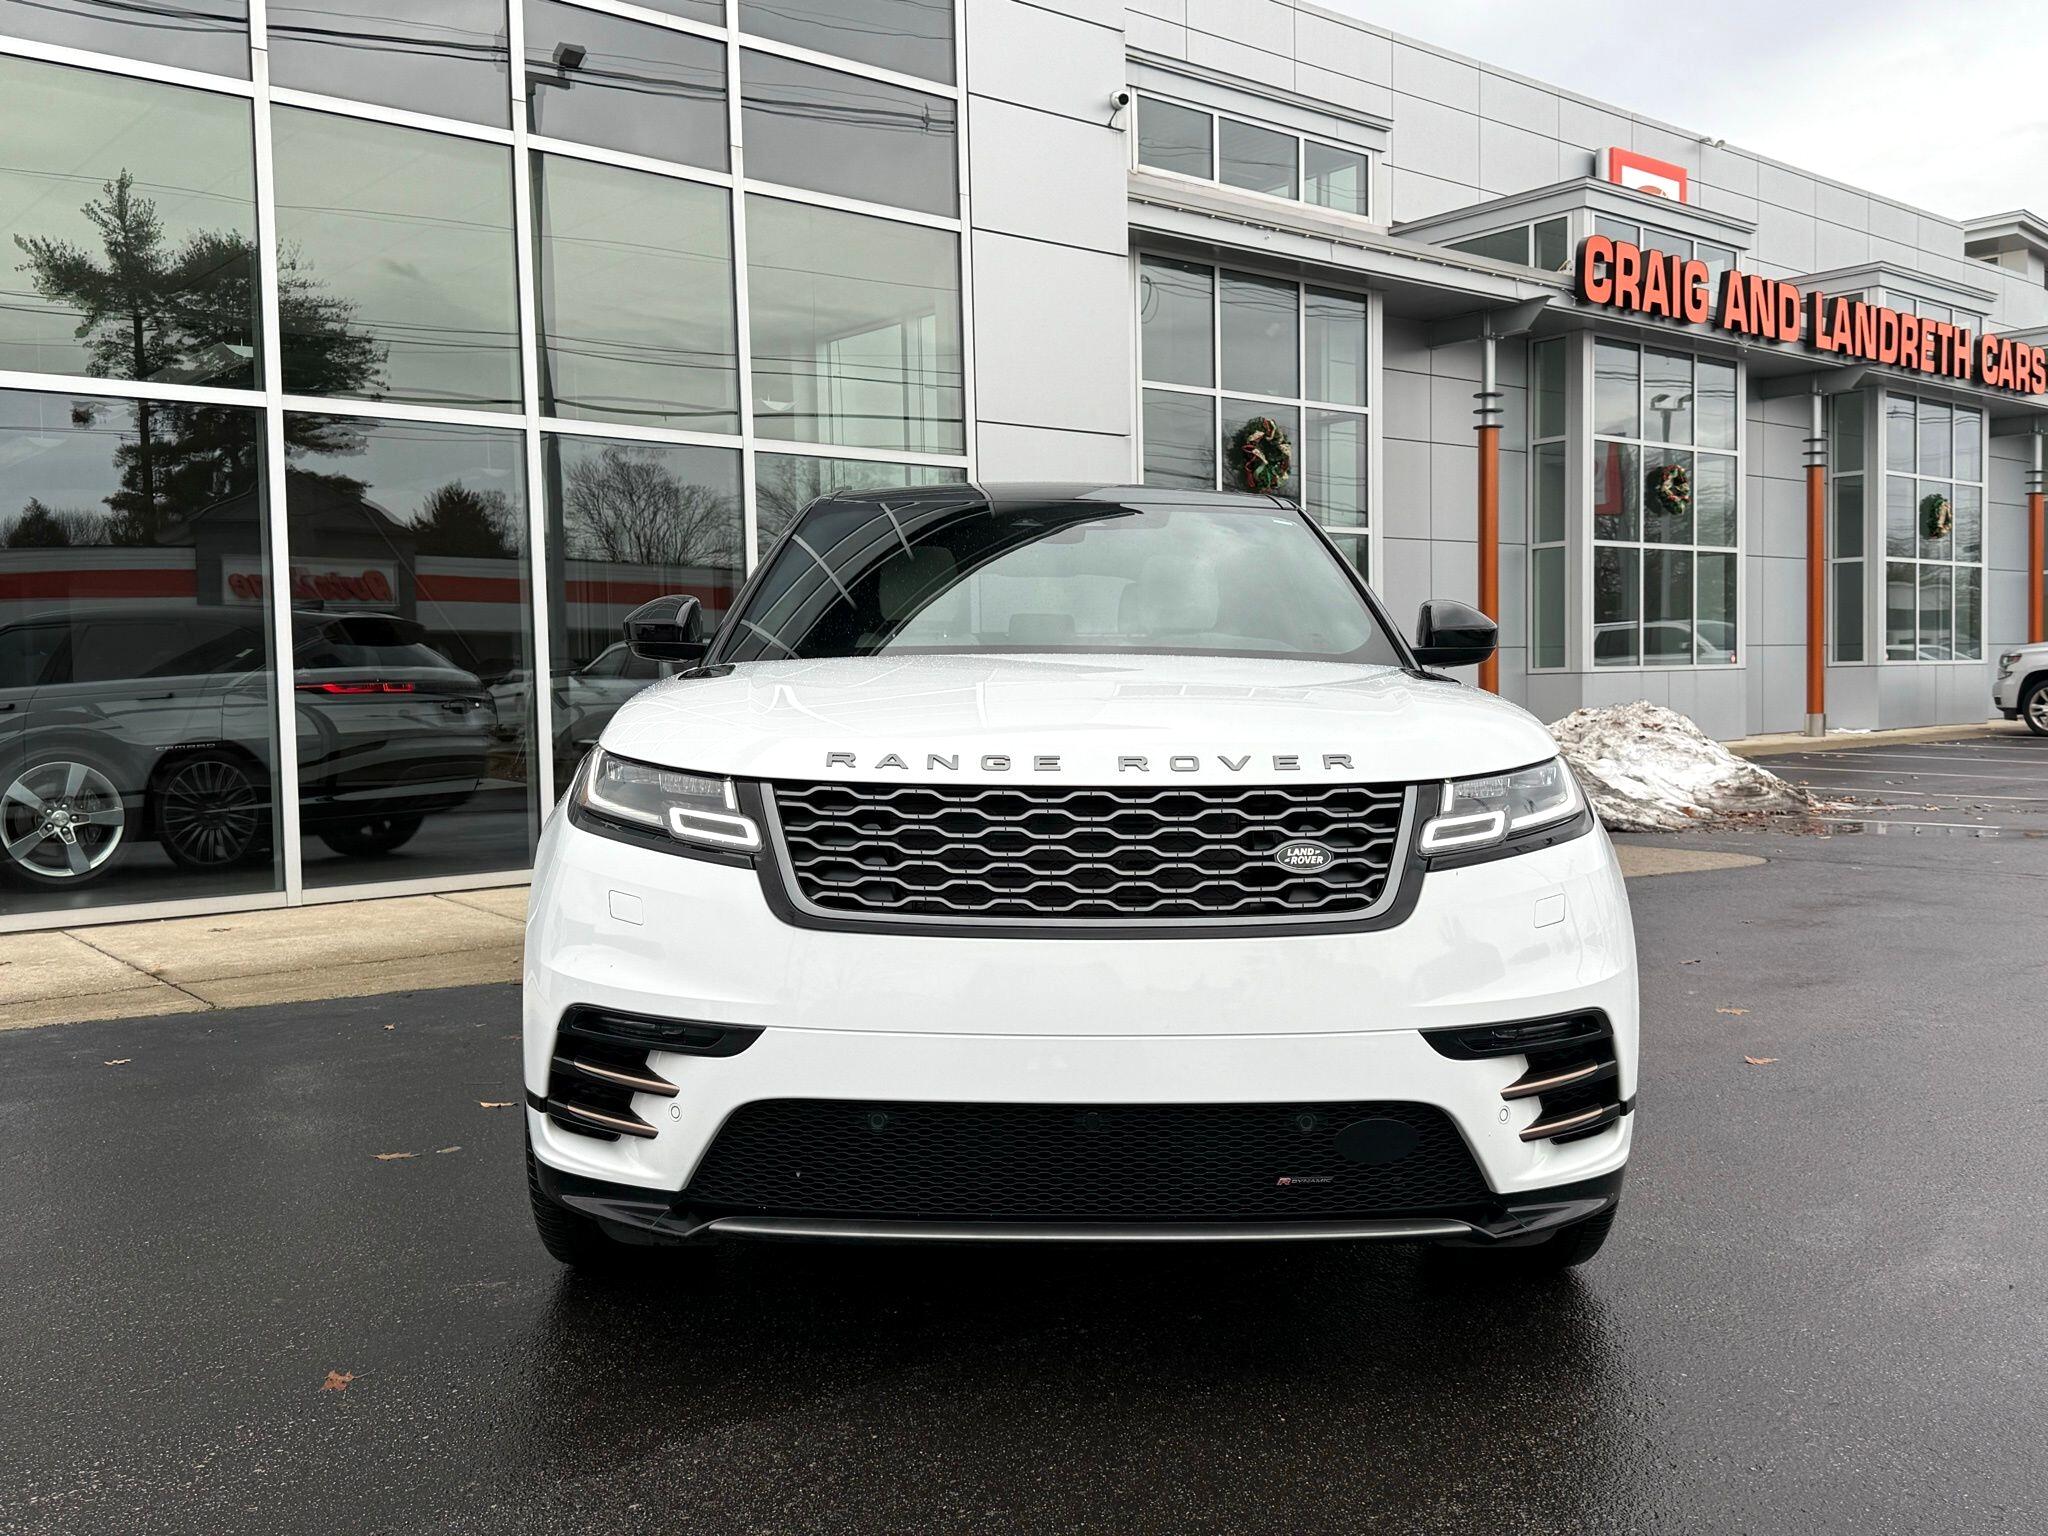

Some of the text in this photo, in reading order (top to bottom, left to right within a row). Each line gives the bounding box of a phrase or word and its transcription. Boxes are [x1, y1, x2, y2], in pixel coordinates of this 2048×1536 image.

[1580, 234, 2047, 395] CRAIG AND LANDRETH CARS
[826, 751, 1355, 772] RANGE ROVER
[1290, 855, 1324, 865] ROVER
